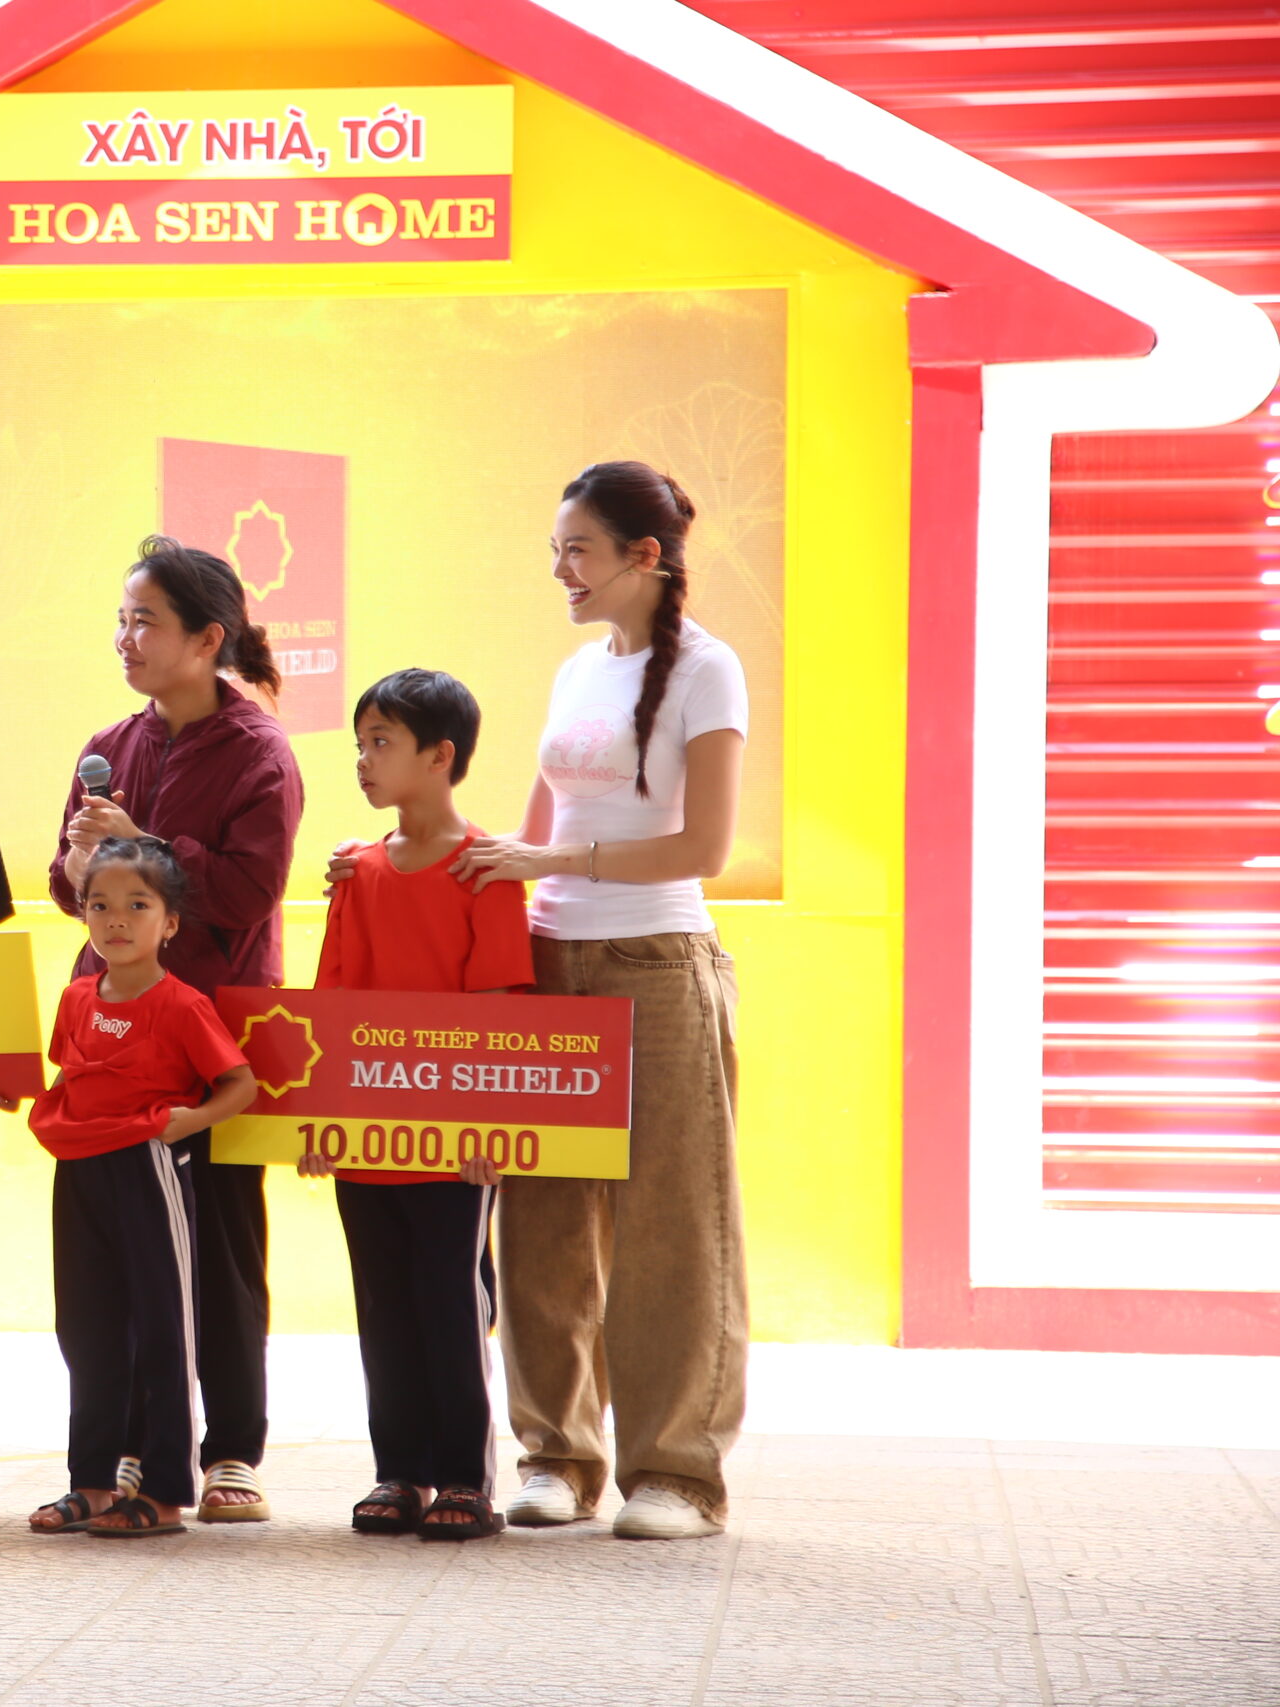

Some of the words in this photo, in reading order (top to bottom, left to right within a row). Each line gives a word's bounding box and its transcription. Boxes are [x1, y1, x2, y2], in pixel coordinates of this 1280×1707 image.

[84, 110, 189, 163] XÂY
[204, 107, 327, 168] NHÀ,
[342, 105, 423, 160] TỚI
[8, 202, 141, 244] HOA
[154, 200, 280, 243] SEN
[294, 192, 496, 247] HOME
[267, 621, 302, 640] HOA
[304, 620, 337, 638] SEN
[273, 648, 338, 677] IELD
[351, 1022, 407, 1048] ỐNG
[413, 1025, 480, 1050] THÉP
[486, 1032, 542, 1052] HOA
[548, 1034, 600, 1054] SEN
[350, 1060, 442, 1091] MAG
[297, 1122, 540, 1172] 10.000.000
